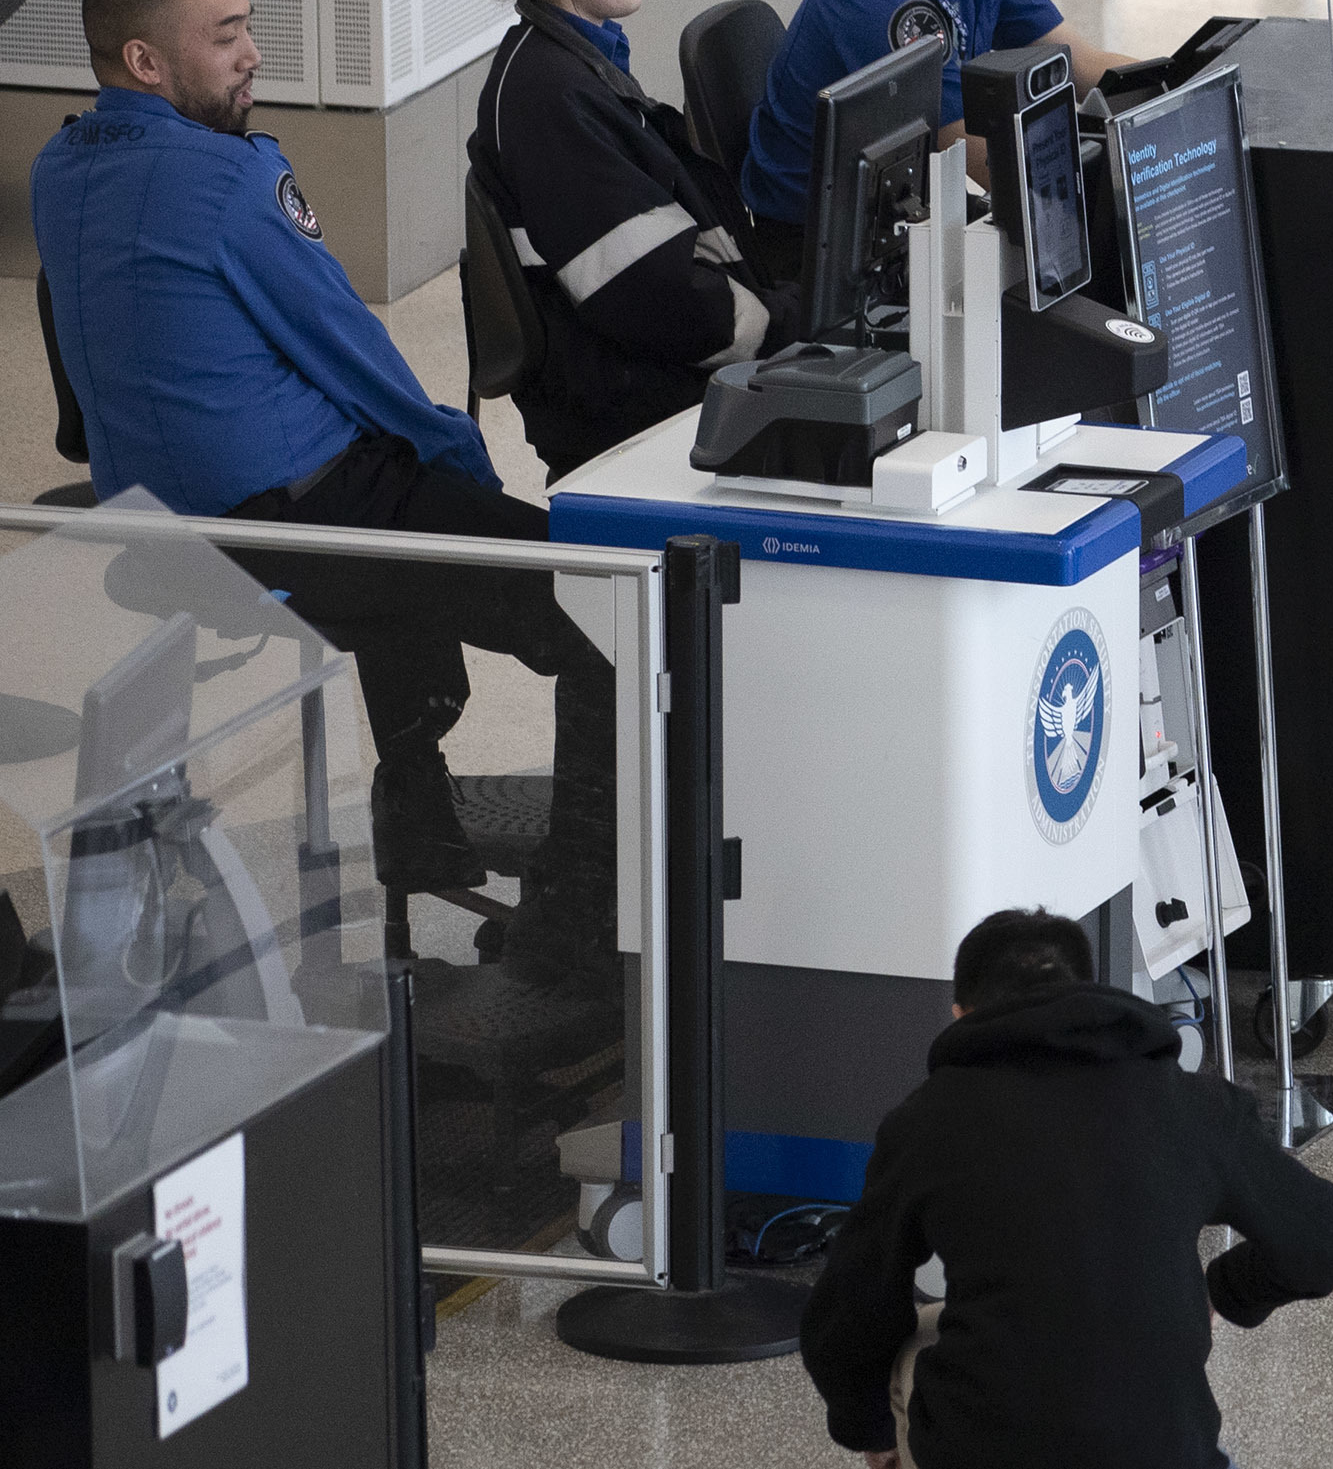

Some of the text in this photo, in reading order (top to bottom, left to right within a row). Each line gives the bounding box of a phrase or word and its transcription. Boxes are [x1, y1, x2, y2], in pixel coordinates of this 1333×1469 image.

[1129, 143, 1157, 165] Identity
[1131, 139, 1217, 186] Verification Technology
[782, 542, 820, 554] IDEMIA
[1026, 609, 1112, 766] TRANSPORTATION SECURITY
[1031, 759, 1105, 843] ADMINISTRATION
